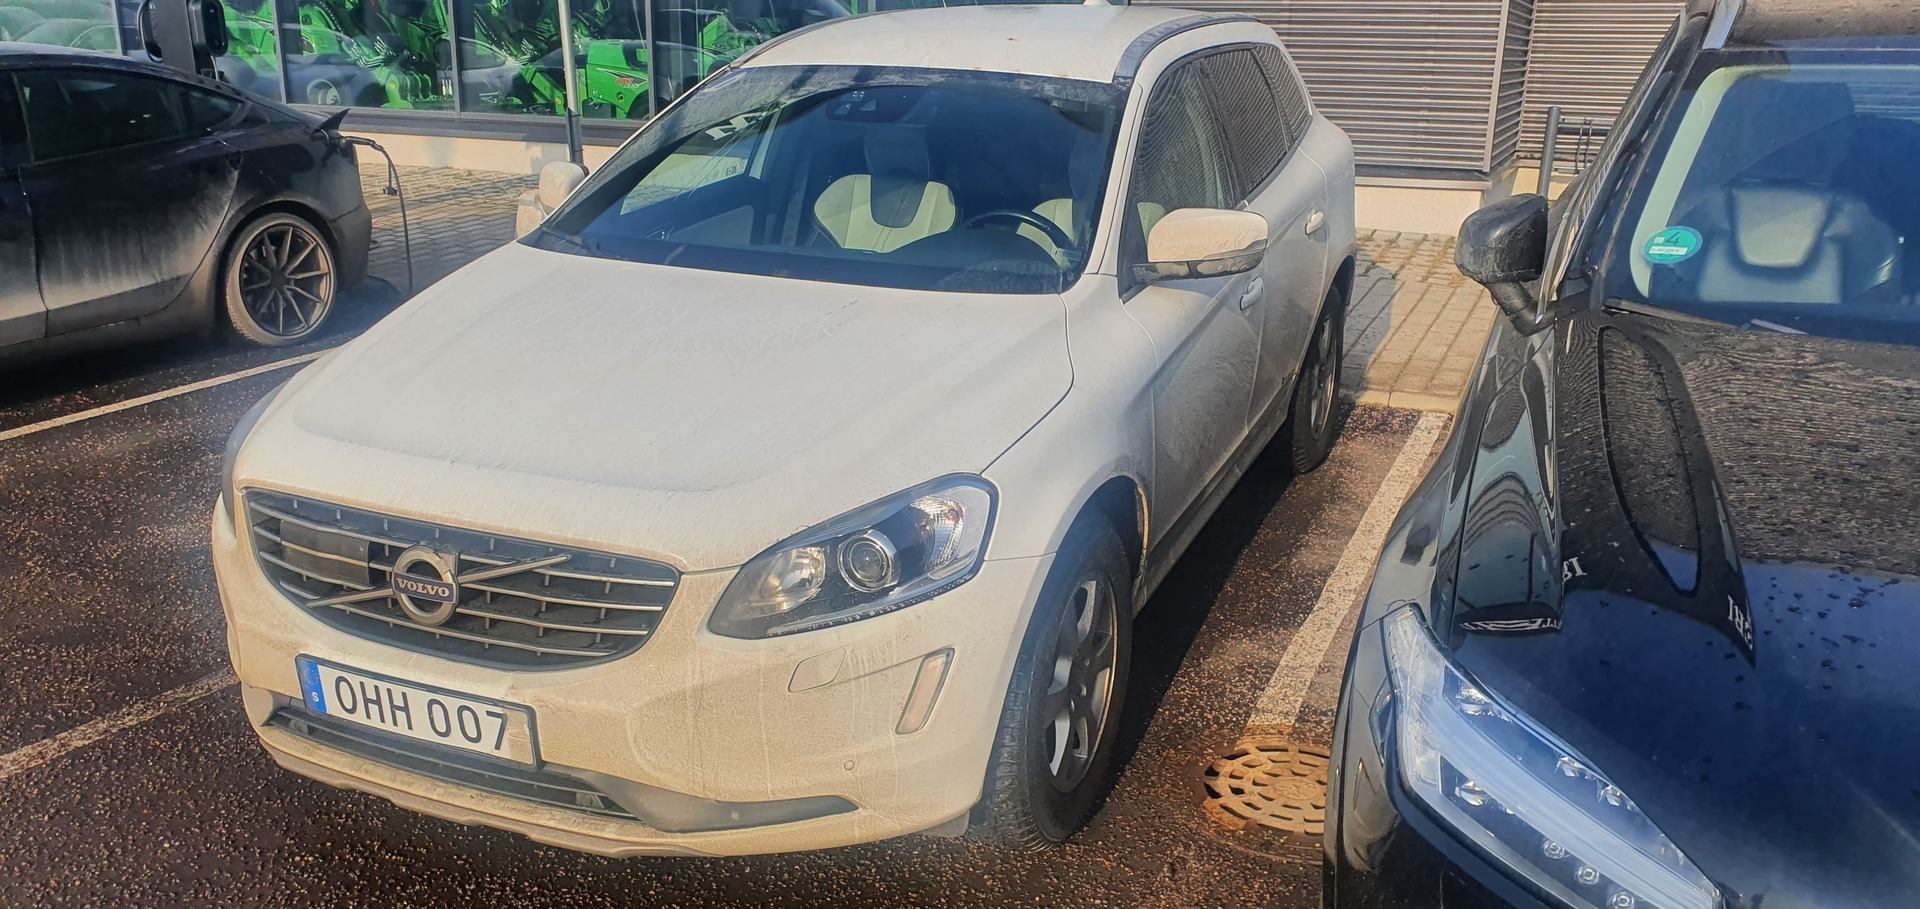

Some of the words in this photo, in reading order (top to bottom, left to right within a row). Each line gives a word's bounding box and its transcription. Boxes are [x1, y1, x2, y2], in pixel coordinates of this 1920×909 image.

[1665, 231, 1681, 246] 4
[396, 577, 450, 597] VOLVO
[312, 691, 319, 703] S
[334, 675, 413, 731] OHH
[427, 698, 509, 751] 007
